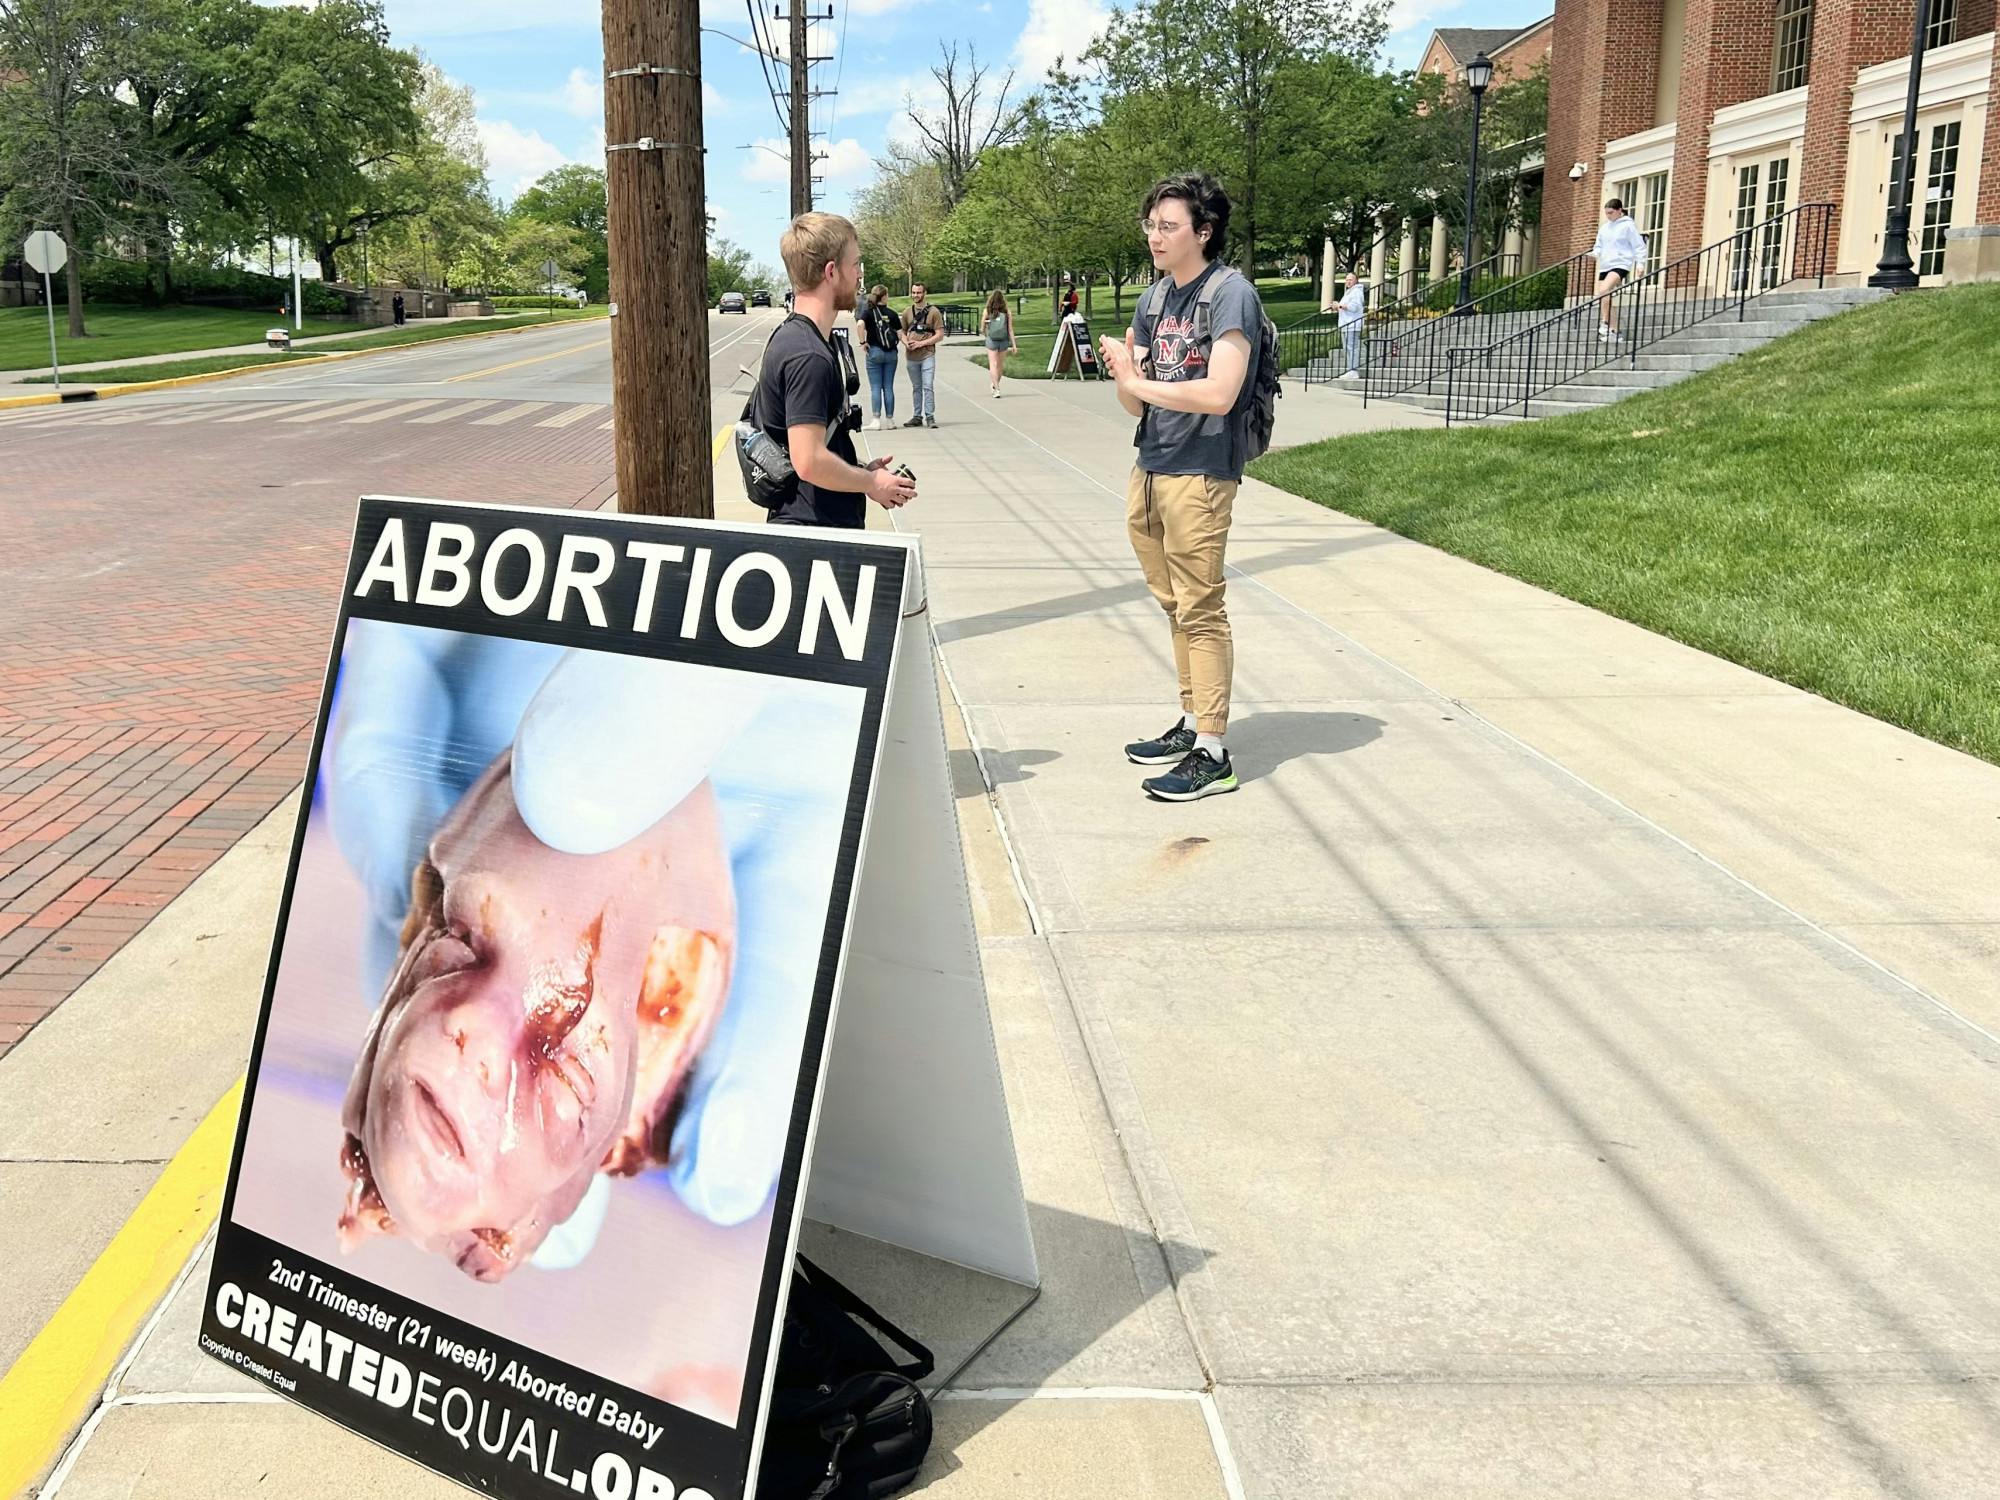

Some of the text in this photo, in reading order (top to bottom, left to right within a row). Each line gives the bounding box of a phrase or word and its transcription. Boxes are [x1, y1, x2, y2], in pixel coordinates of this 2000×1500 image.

[353, 517, 877, 662] ABORTION
[201, 1333, 235, 1361] Copyright
[243, 1355, 273, 1380] Created
[273, 1370, 297, 1392] Equal
[215, 1282, 716, 1500] CREATEDEQUAL.OR
[268, 1258, 664, 1450] 2nd Trimester (21 week) Aborted Baby
